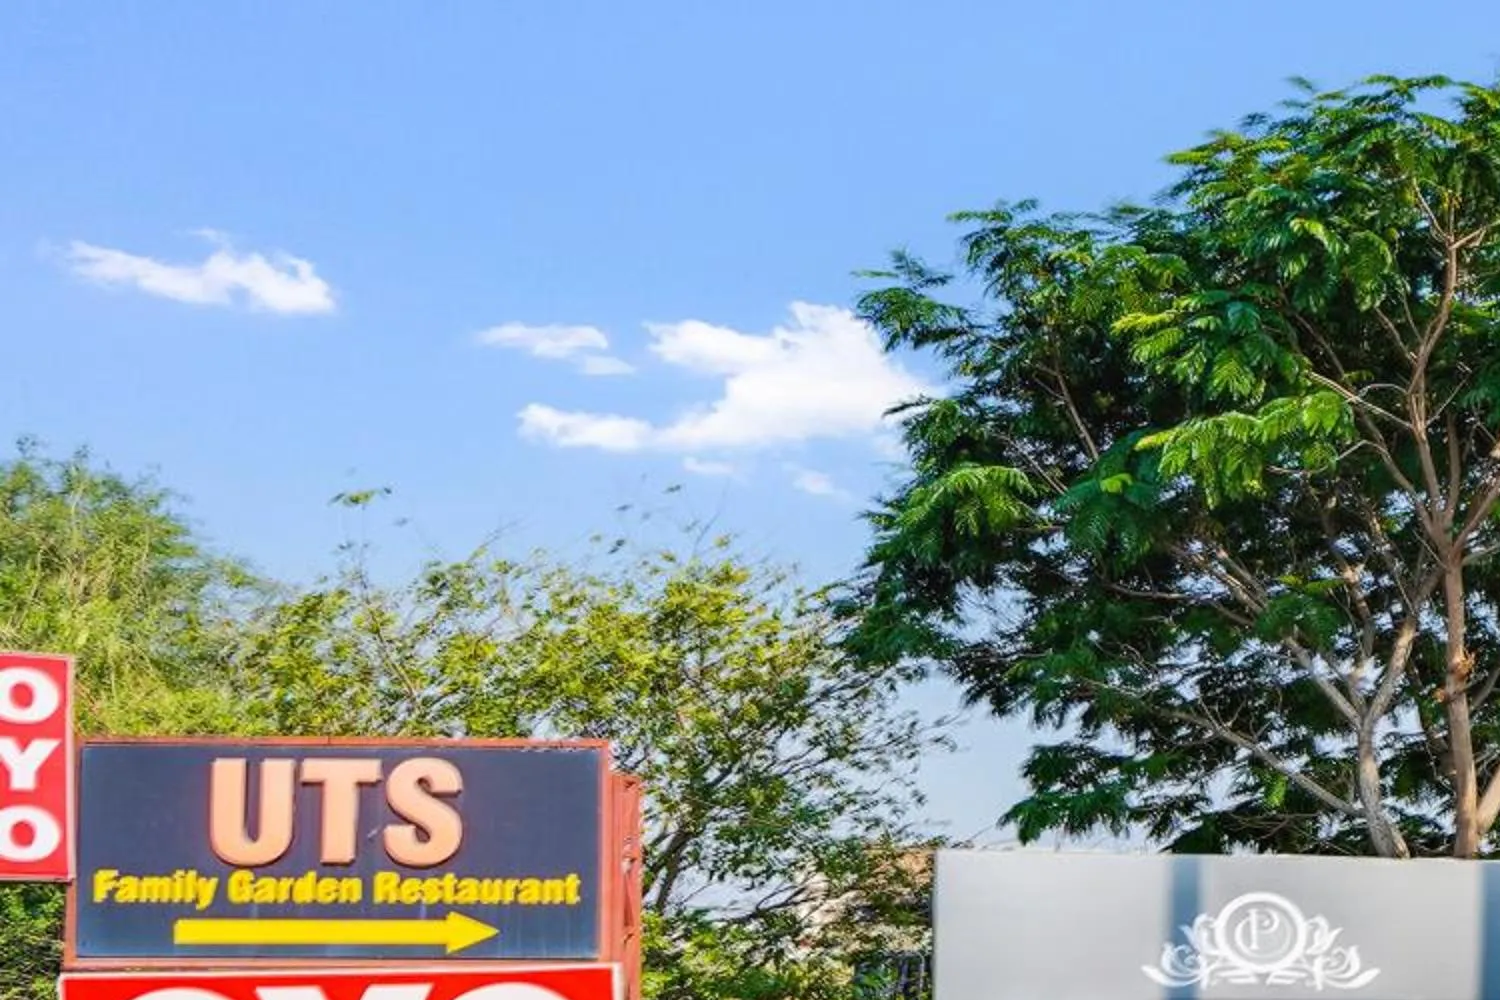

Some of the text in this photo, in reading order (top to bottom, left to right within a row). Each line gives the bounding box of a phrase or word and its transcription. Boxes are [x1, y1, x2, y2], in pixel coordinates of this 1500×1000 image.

[0, 666, 61, 863] OYO
[208, 756, 464, 867] UTS
[93, 868, 582, 910] Family Garden Restaurant
